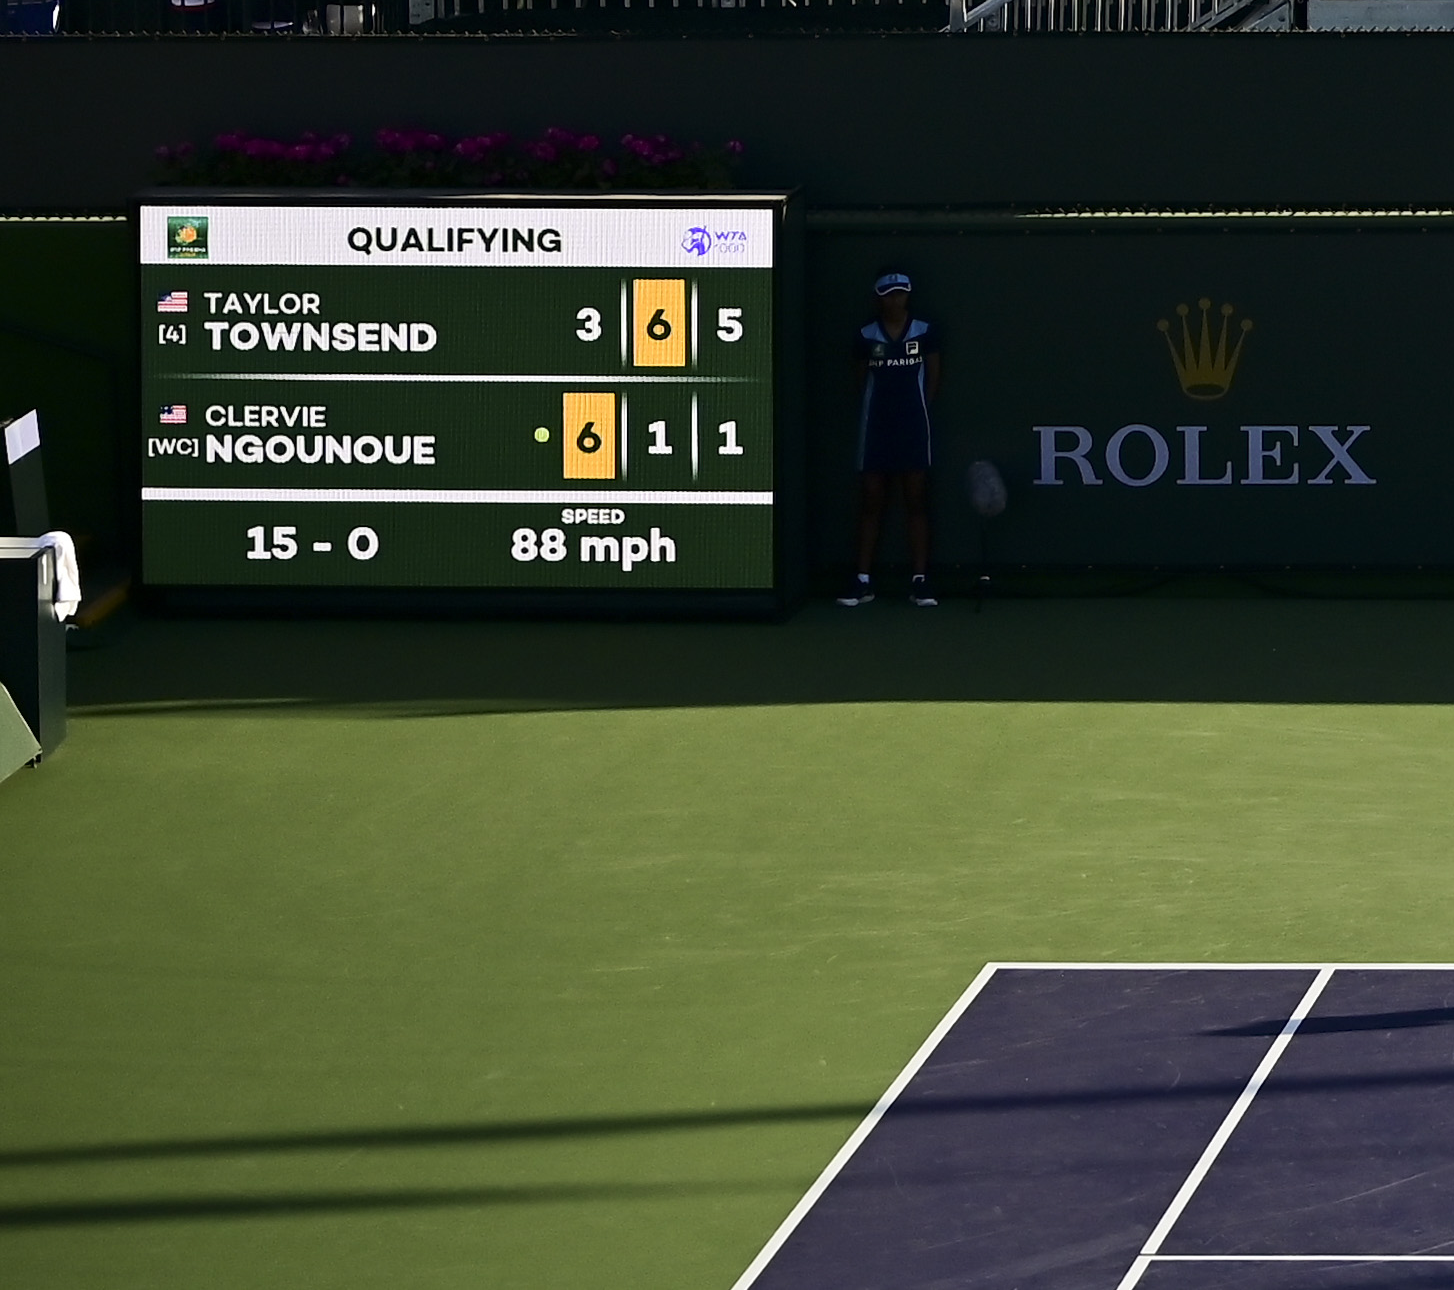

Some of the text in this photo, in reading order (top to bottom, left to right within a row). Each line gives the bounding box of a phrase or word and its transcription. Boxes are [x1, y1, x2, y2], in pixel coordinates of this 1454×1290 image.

[347, 226, 562, 256] QUALIFYING
[714, 231, 748, 241] WTA
[203, 292, 320, 315] TAYLOR
[158, 321, 438, 352] [4] TOWNSEND
[575, 307, 743, 342] 3 6 5
[205, 405, 327, 428] CLERVIE
[148, 434, 436, 465] [WC] NGOUNOUE
[576, 420, 744, 455] 6 1 1
[1032, 424, 1377, 487] ROLEX
[561, 508, 626, 525] SPEED
[246, 525, 298, 560] 15
[347, 526, 379, 561] 0
[510, 527, 676, 572] 88 mph
